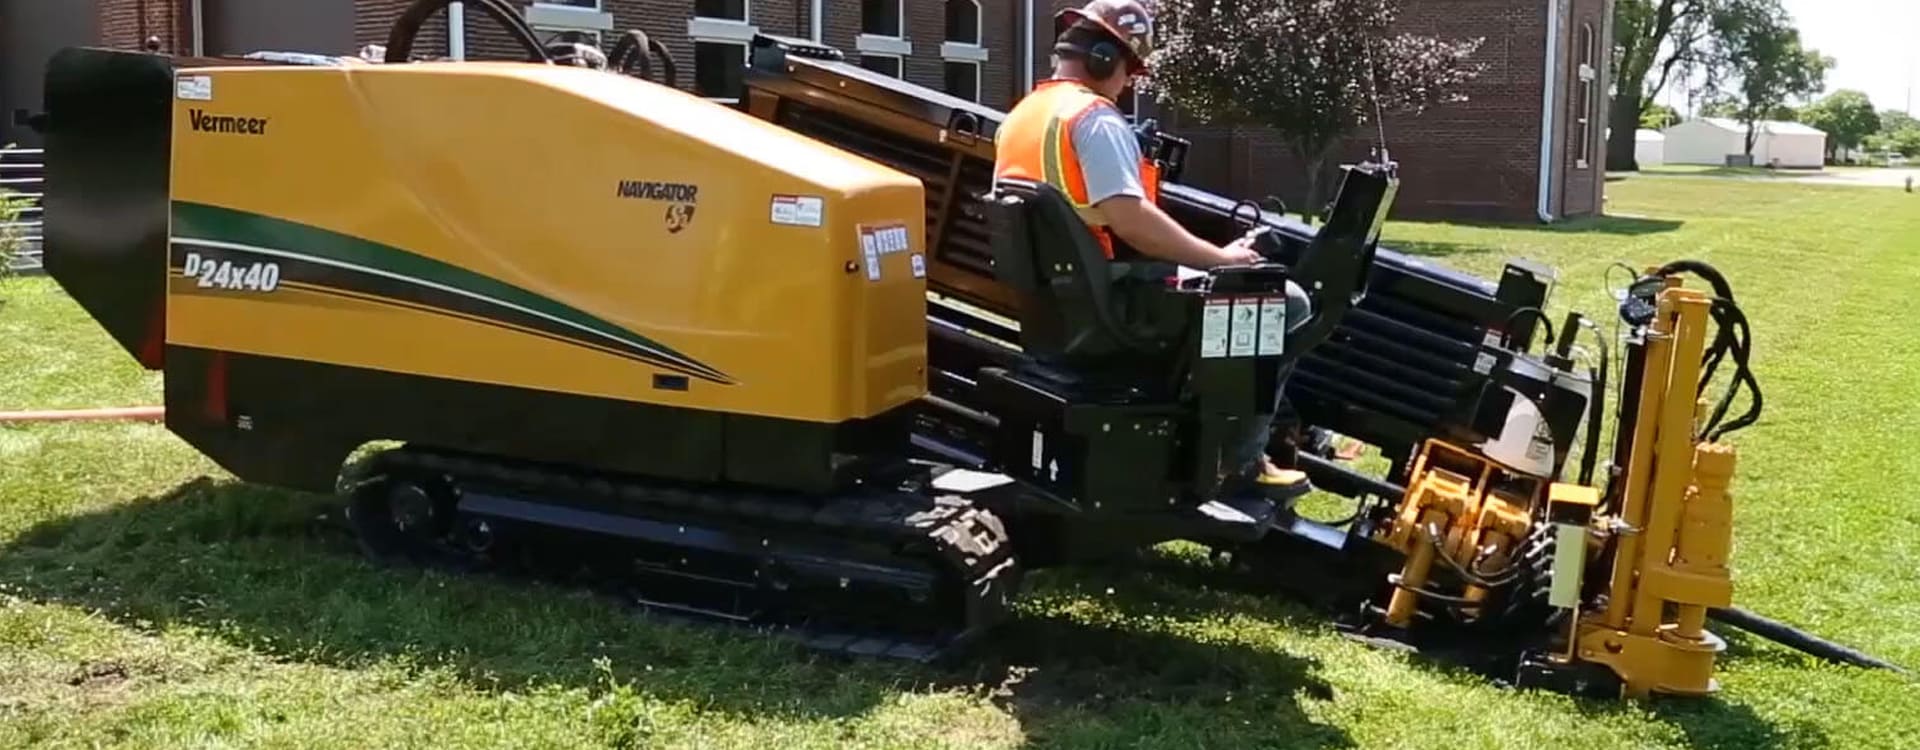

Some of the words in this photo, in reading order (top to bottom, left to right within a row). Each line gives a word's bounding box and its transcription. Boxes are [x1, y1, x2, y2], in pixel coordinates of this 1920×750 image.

[189, 108, 267, 135] Vermeer
[617, 180, 698, 203] NAVIGATOR
[183, 252, 280, 292] D24x40
